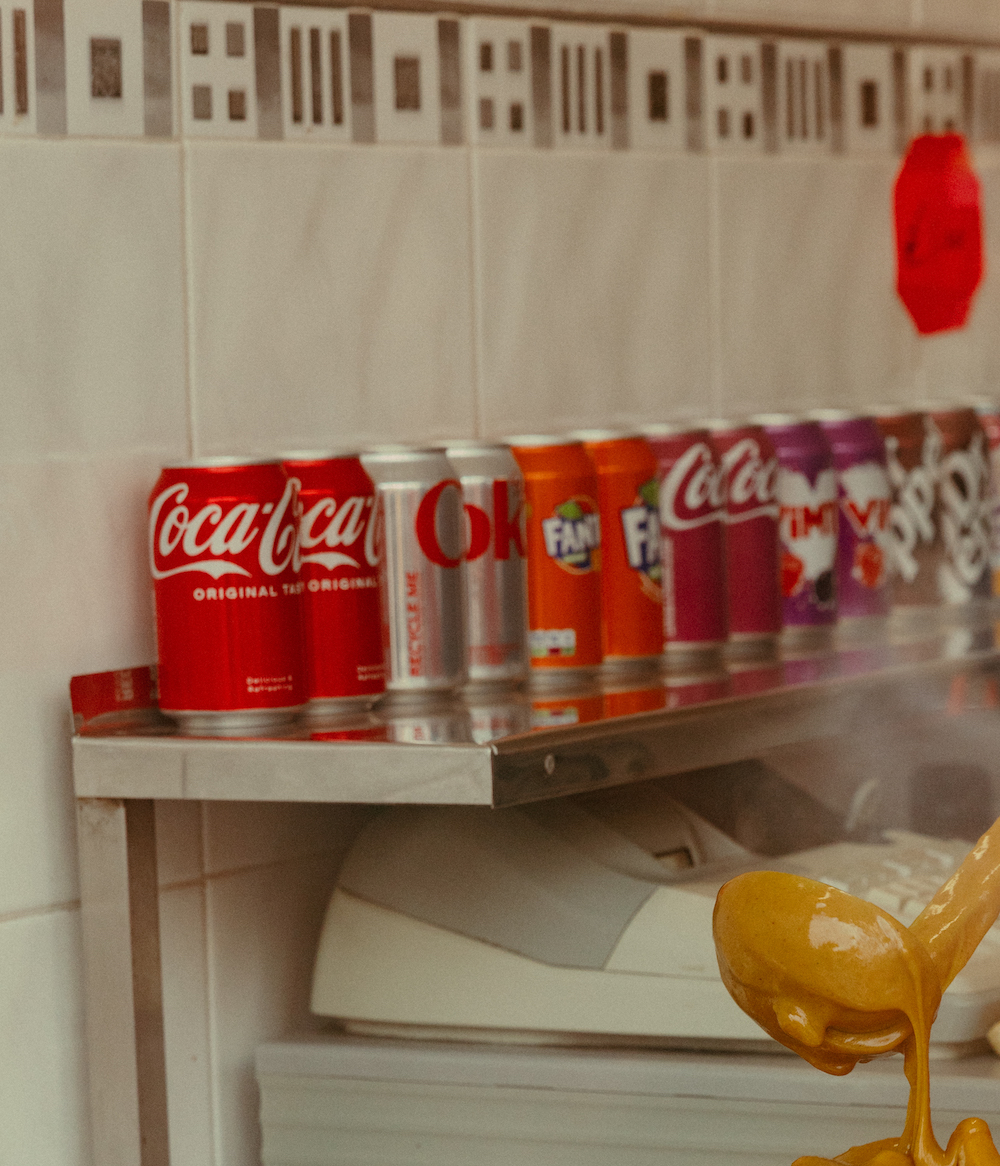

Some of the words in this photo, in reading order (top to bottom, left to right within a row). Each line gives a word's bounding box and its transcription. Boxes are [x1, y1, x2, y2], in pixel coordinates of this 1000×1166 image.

[193, 585, 279, 601] ORIGINAL
[406, 571, 419, 598] ME
[406, 603, 421, 678] RECYCLE
